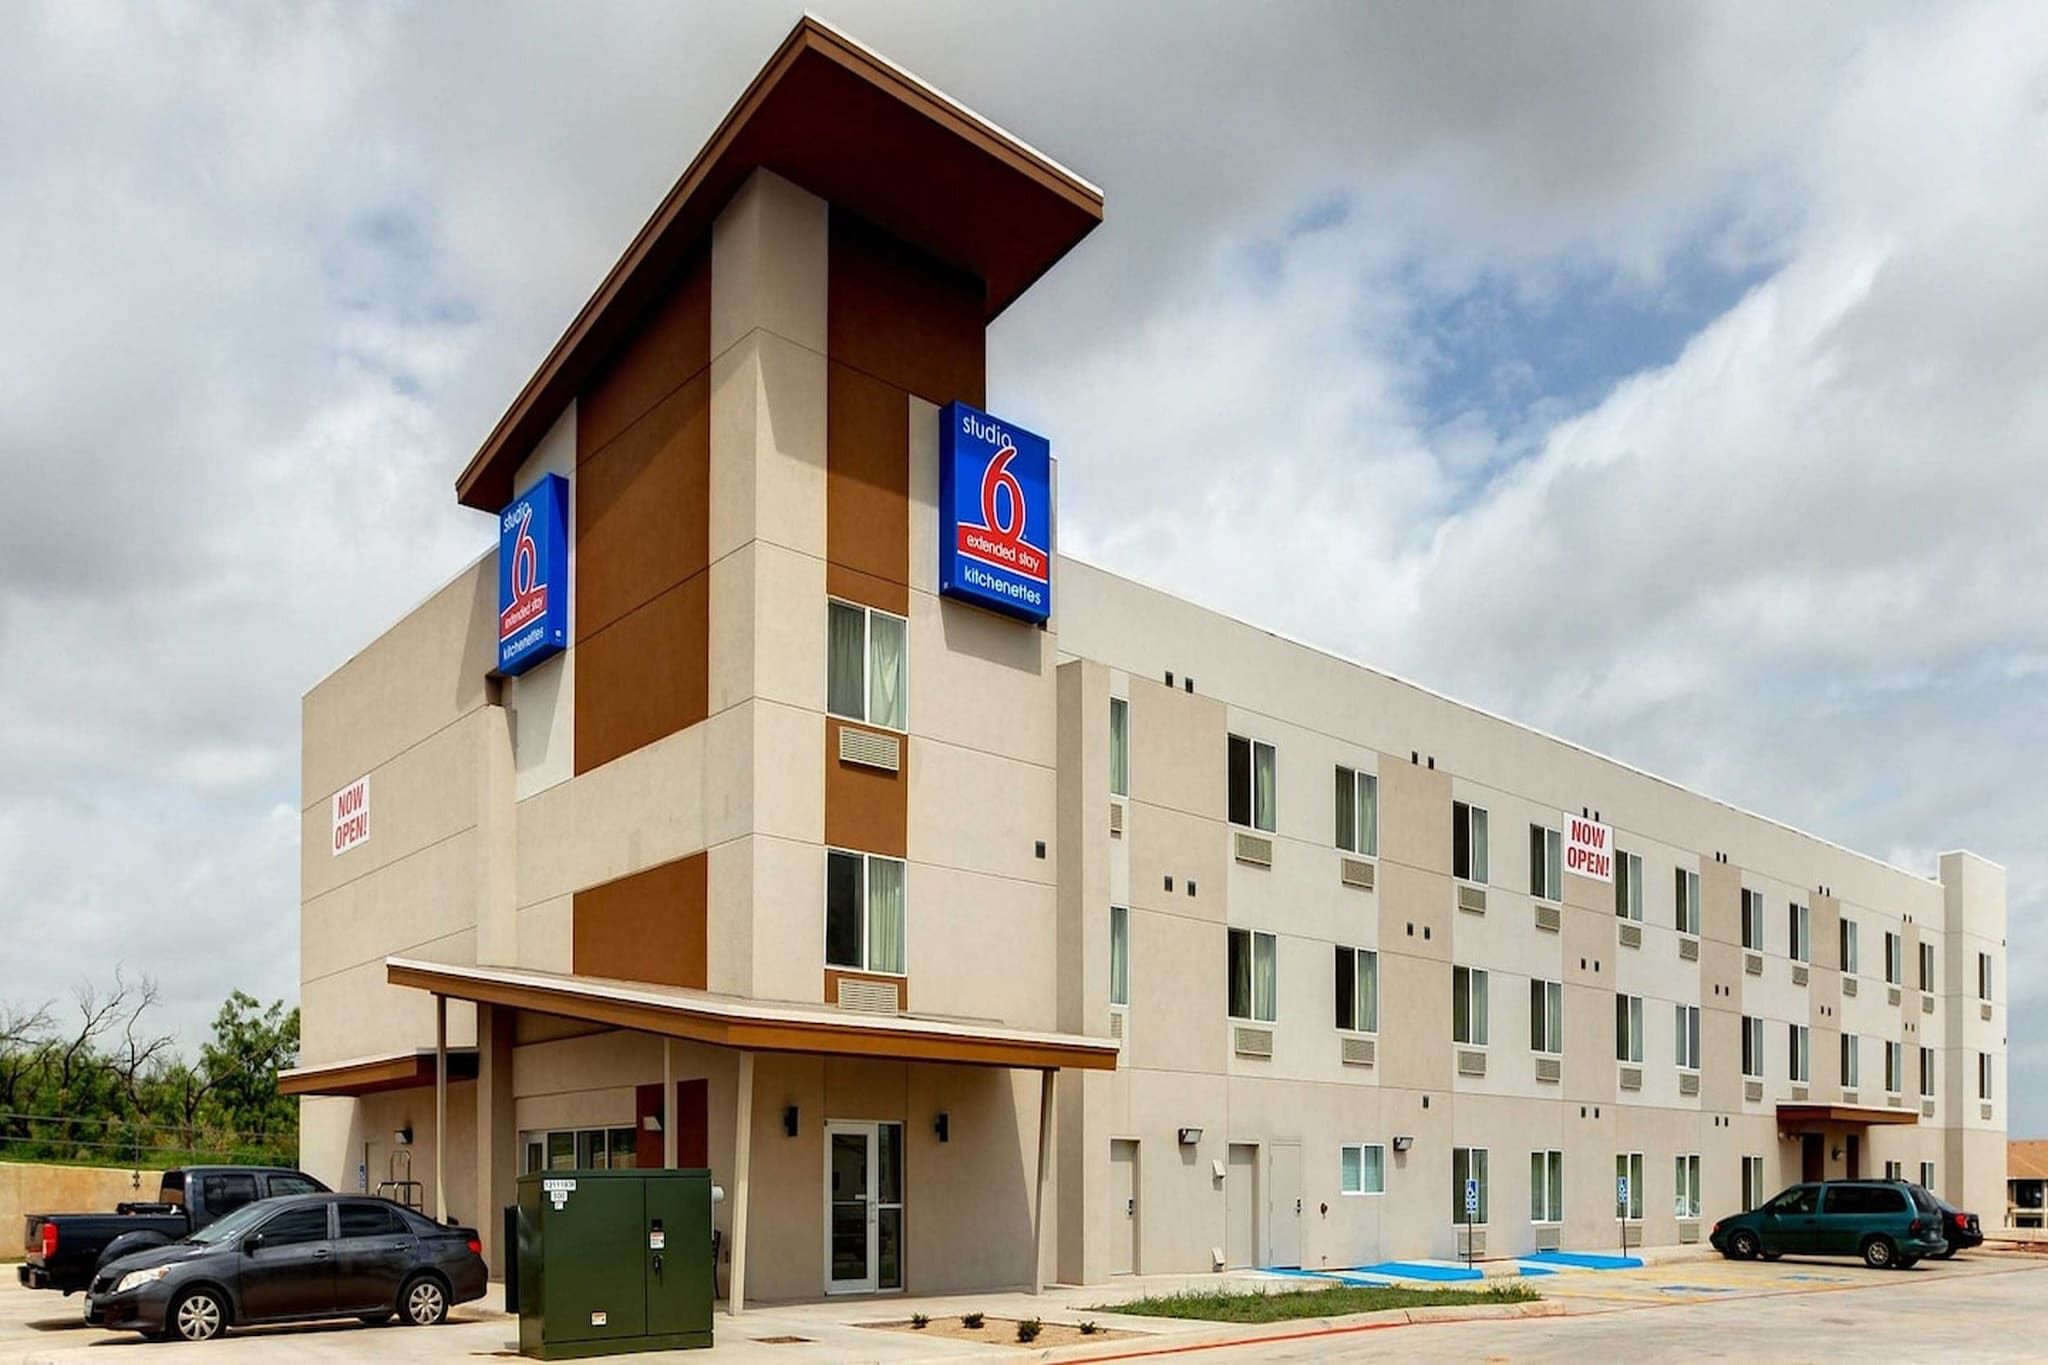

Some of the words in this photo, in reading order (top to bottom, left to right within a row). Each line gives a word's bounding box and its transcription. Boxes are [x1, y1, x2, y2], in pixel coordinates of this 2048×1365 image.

[962, 413, 1012, 448] studio
[980, 446, 1026, 541] 6
[503, 501, 529, 534] studio
[511, 508, 537, 601] 6
[966, 532, 1017, 563] extended
[1018, 548, 1040, 573] stay
[964, 565, 1041, 606] kitchenettes
[504, 604, 530, 629] extended
[530, 595, 544, 616] stay
[502, 625, 544, 660] kitchenettes
[338, 783, 364, 820] NOW
[335, 811, 368, 850] OPEN!
[1571, 819, 1605, 849] NOW
[1567, 846, 1610, 877] OPEN!
